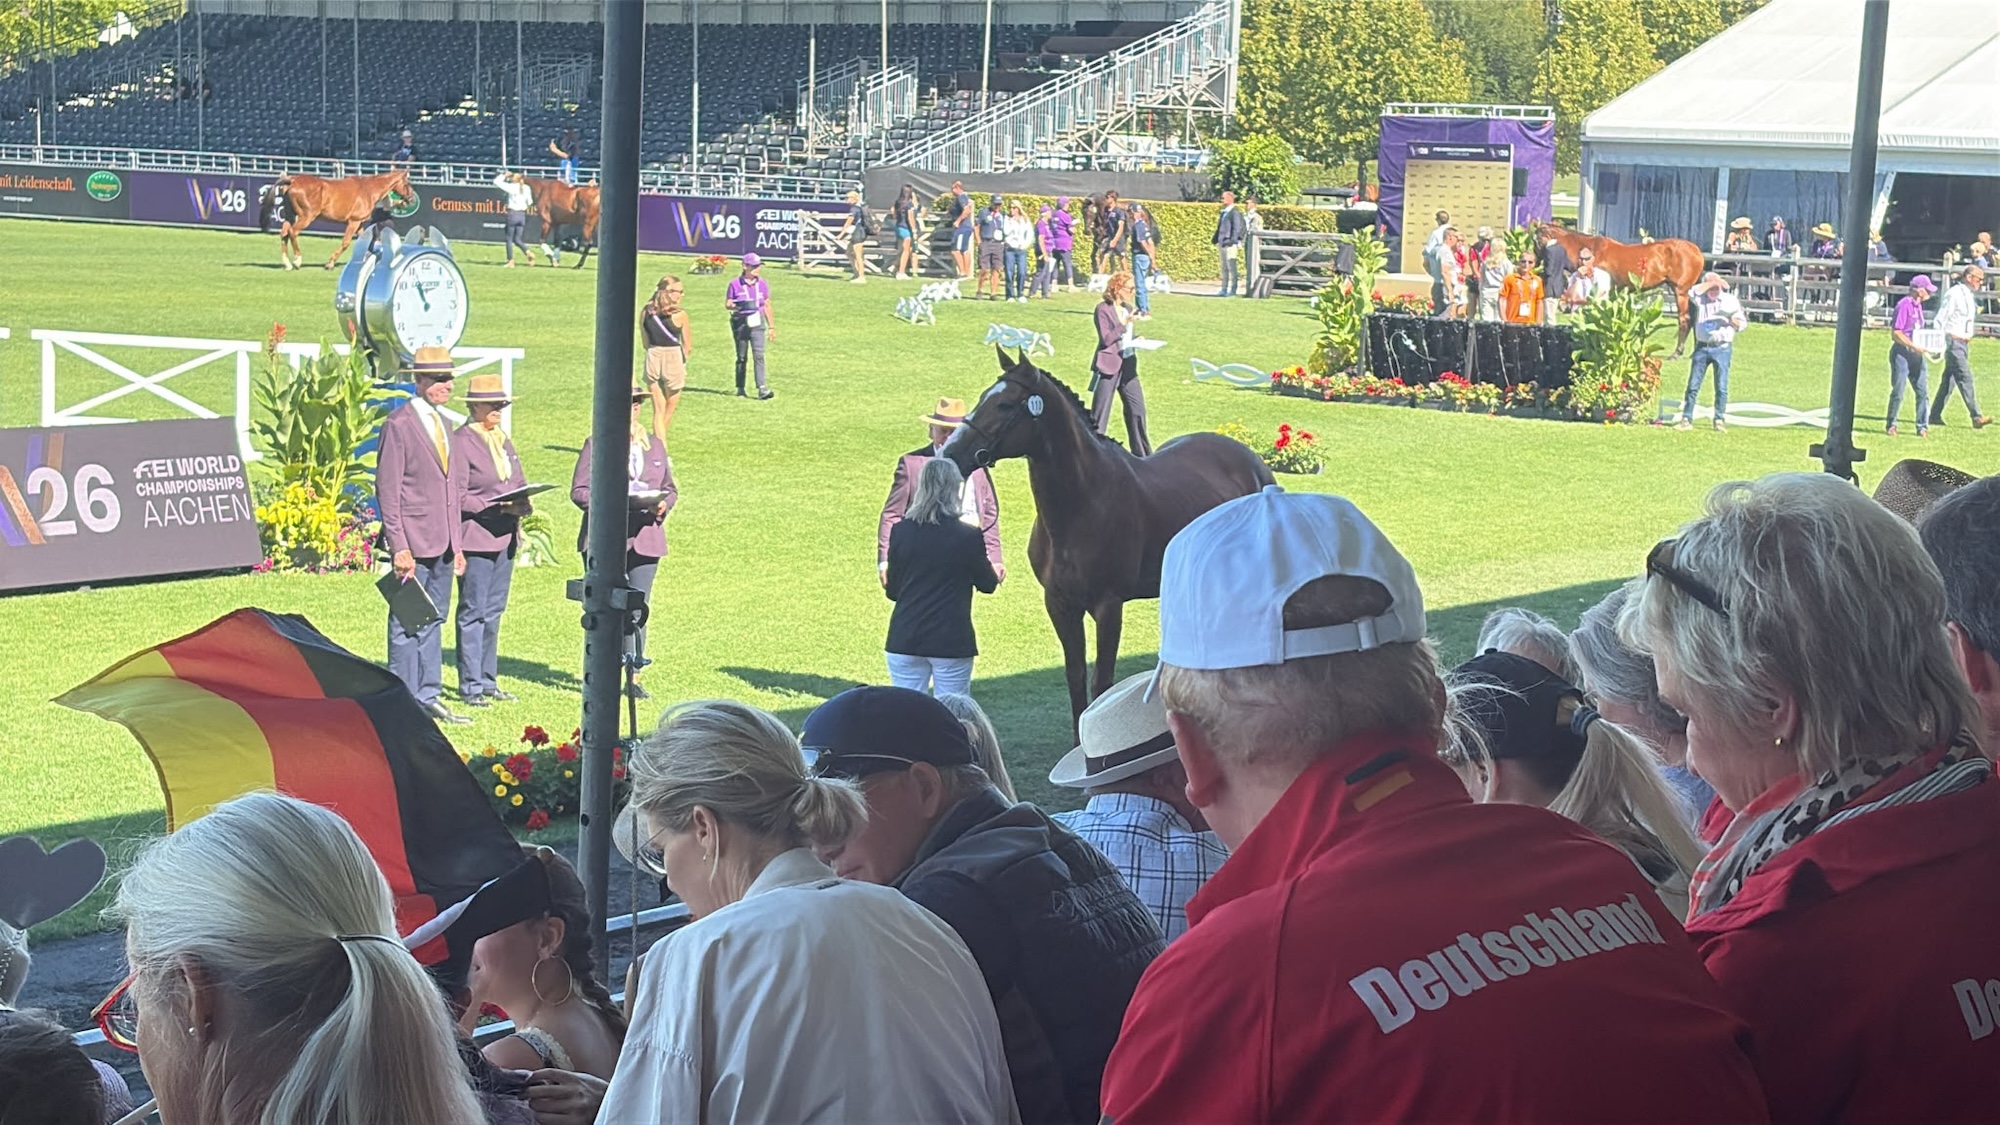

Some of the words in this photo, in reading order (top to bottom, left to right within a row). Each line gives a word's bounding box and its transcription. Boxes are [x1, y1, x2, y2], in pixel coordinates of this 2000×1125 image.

[14, 174, 77, 191] Leidenschaft.
[432, 197, 473, 213] Genuss
[475, 198, 494, 214] mit
[133, 459, 174, 479] FEI
[176, 455, 241, 476] WORLD
[135, 475, 245, 497] CHAMPIONSHIPS
[143, 493, 251, 529] AACHEN
[1348, 892, 1666, 1034] Deutschland
